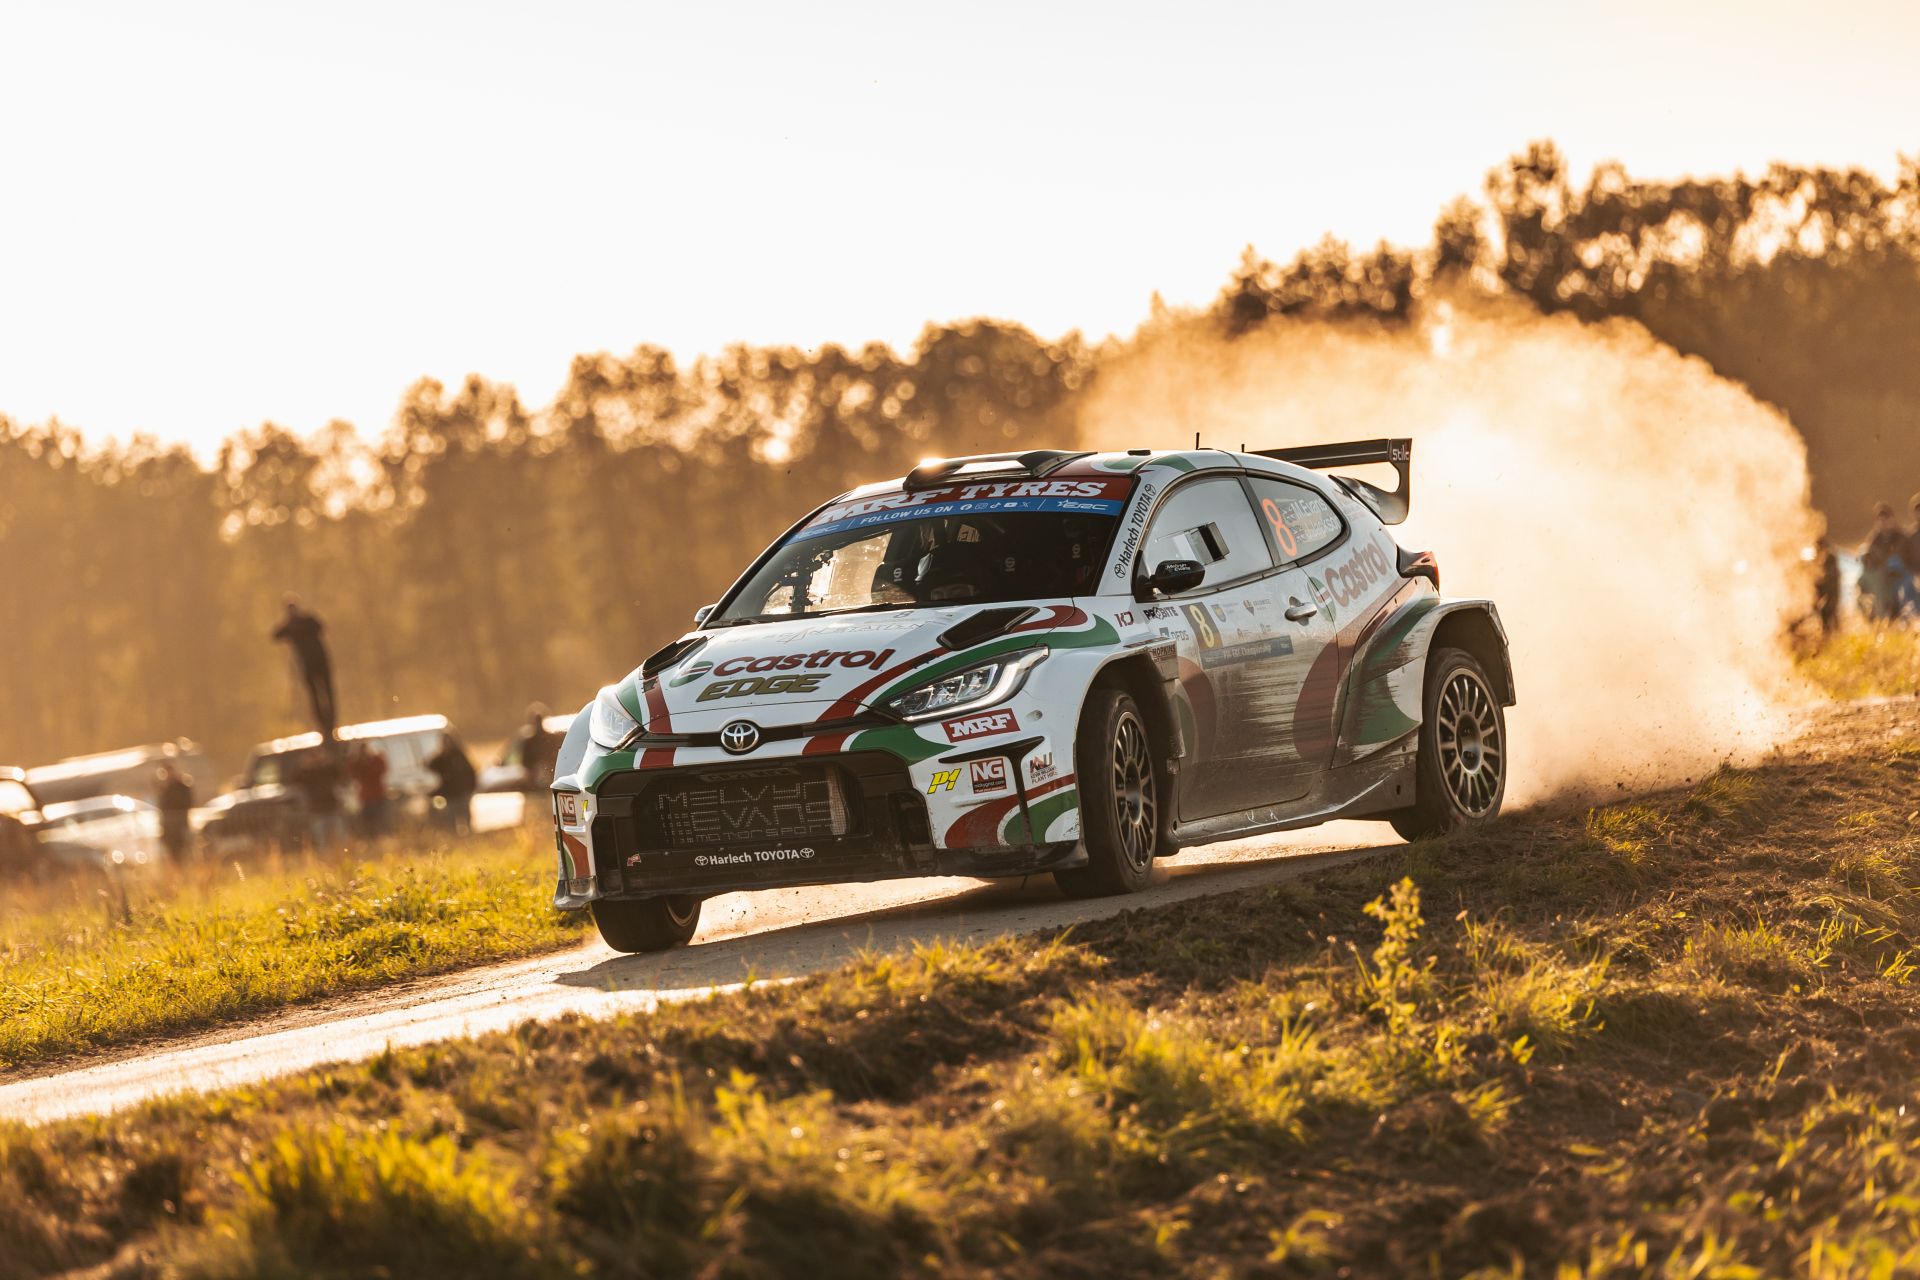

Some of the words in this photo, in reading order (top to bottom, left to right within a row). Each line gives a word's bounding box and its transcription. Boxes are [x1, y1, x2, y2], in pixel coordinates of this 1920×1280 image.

[808, 487, 954, 526] MRF
[959, 481, 1108, 500] TYRES
[859, 510, 912, 525] FOLLOW
[914, 507, 934, 516] US
[934, 505, 953, 513] ON
[1118, 526, 1140, 567] Harlech
[1131, 492, 1153, 528] TOYOTA
[1262, 498, 1297, 557] 8
[1324, 532, 1392, 608] Castrol
[1189, 605, 1215, 648] 8
[713, 648, 896, 677] Castrol
[696, 673, 832, 702] EDGE
[949, 713, 1012, 738] MRF
[971, 760, 1004, 782] NG
[560, 796, 576, 814] NG
[690, 801, 834, 832] EVANS
[709, 852, 752, 866] Harlech
[754, 849, 801, 862] TOYOTA
